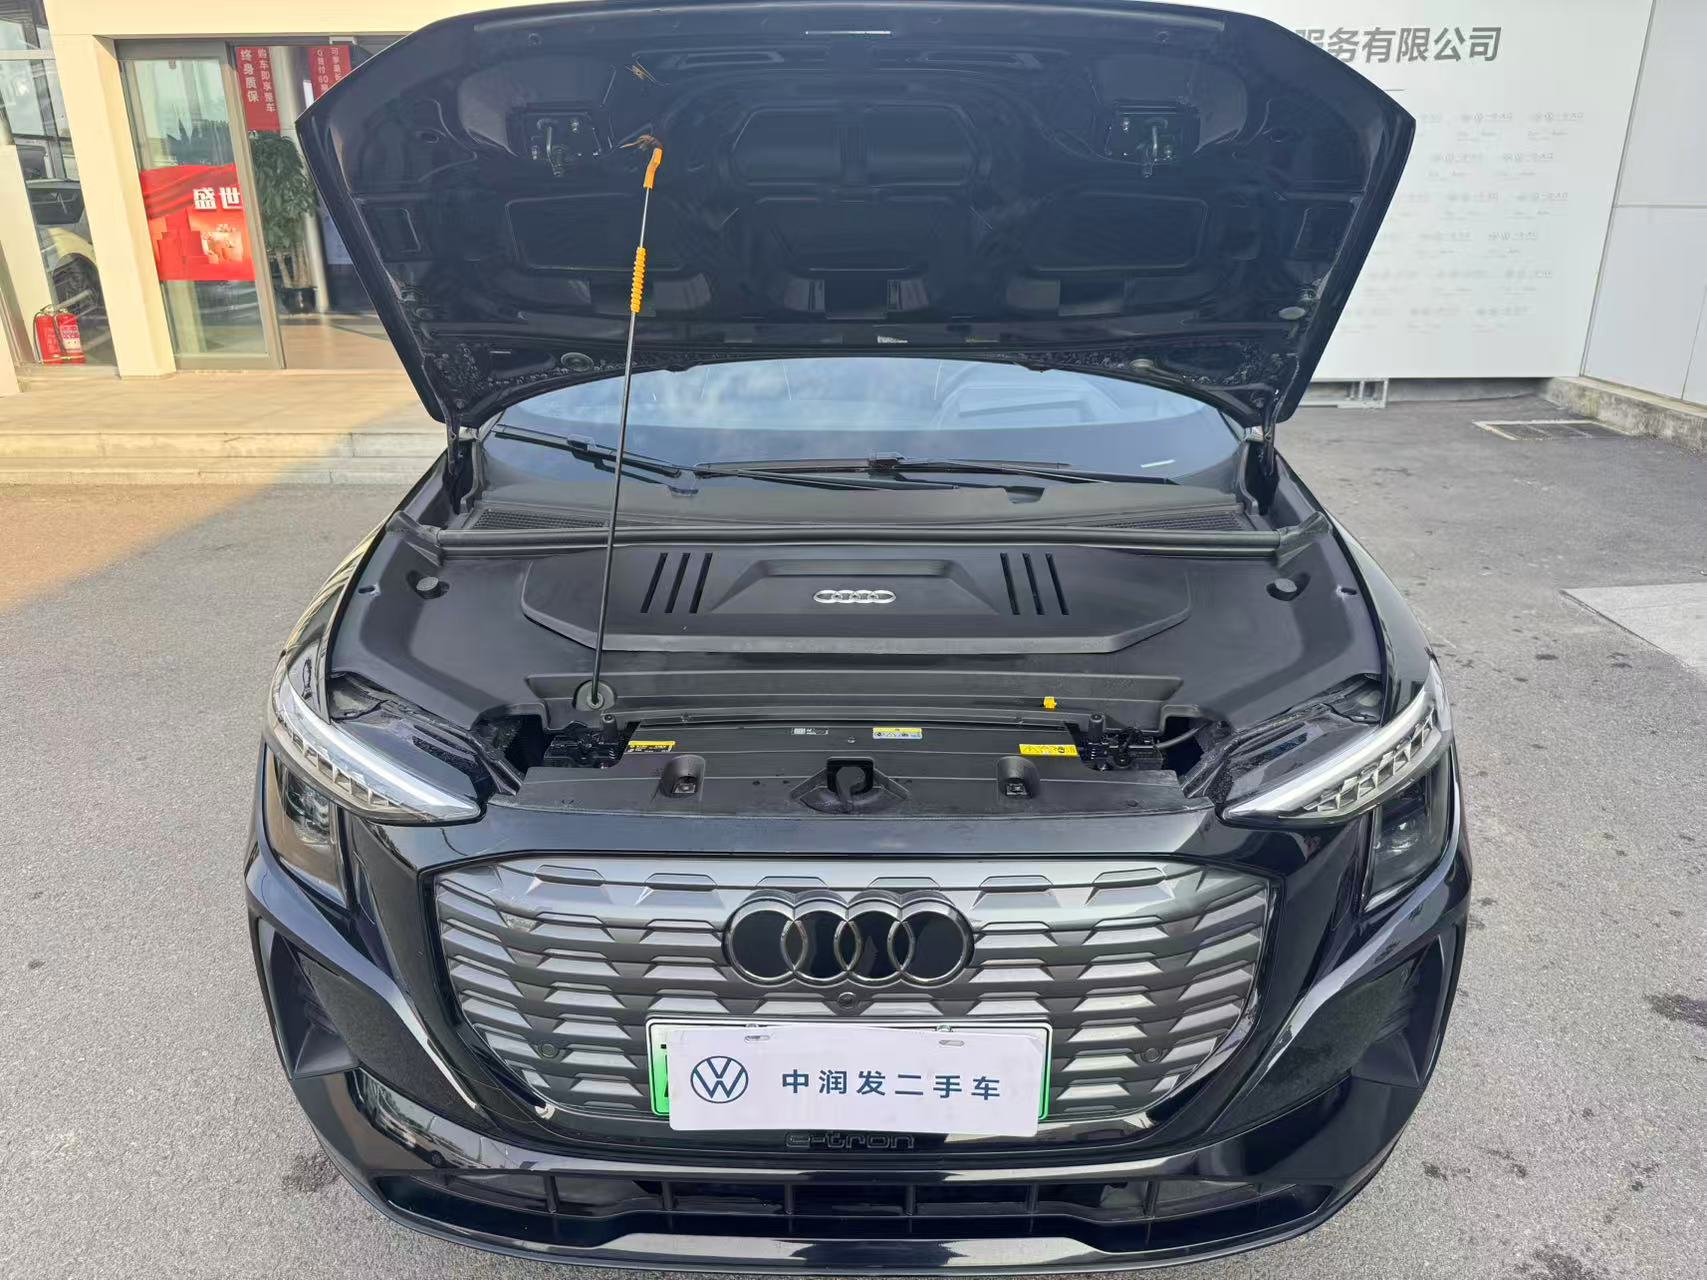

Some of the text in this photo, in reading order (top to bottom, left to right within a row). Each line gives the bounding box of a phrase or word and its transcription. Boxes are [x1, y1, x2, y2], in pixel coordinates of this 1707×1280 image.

[193, 187, 242, 210] 盛世
[781, 1068, 1001, 1101] 中润发二手车
[785, 1129, 915, 1149] e-tron
